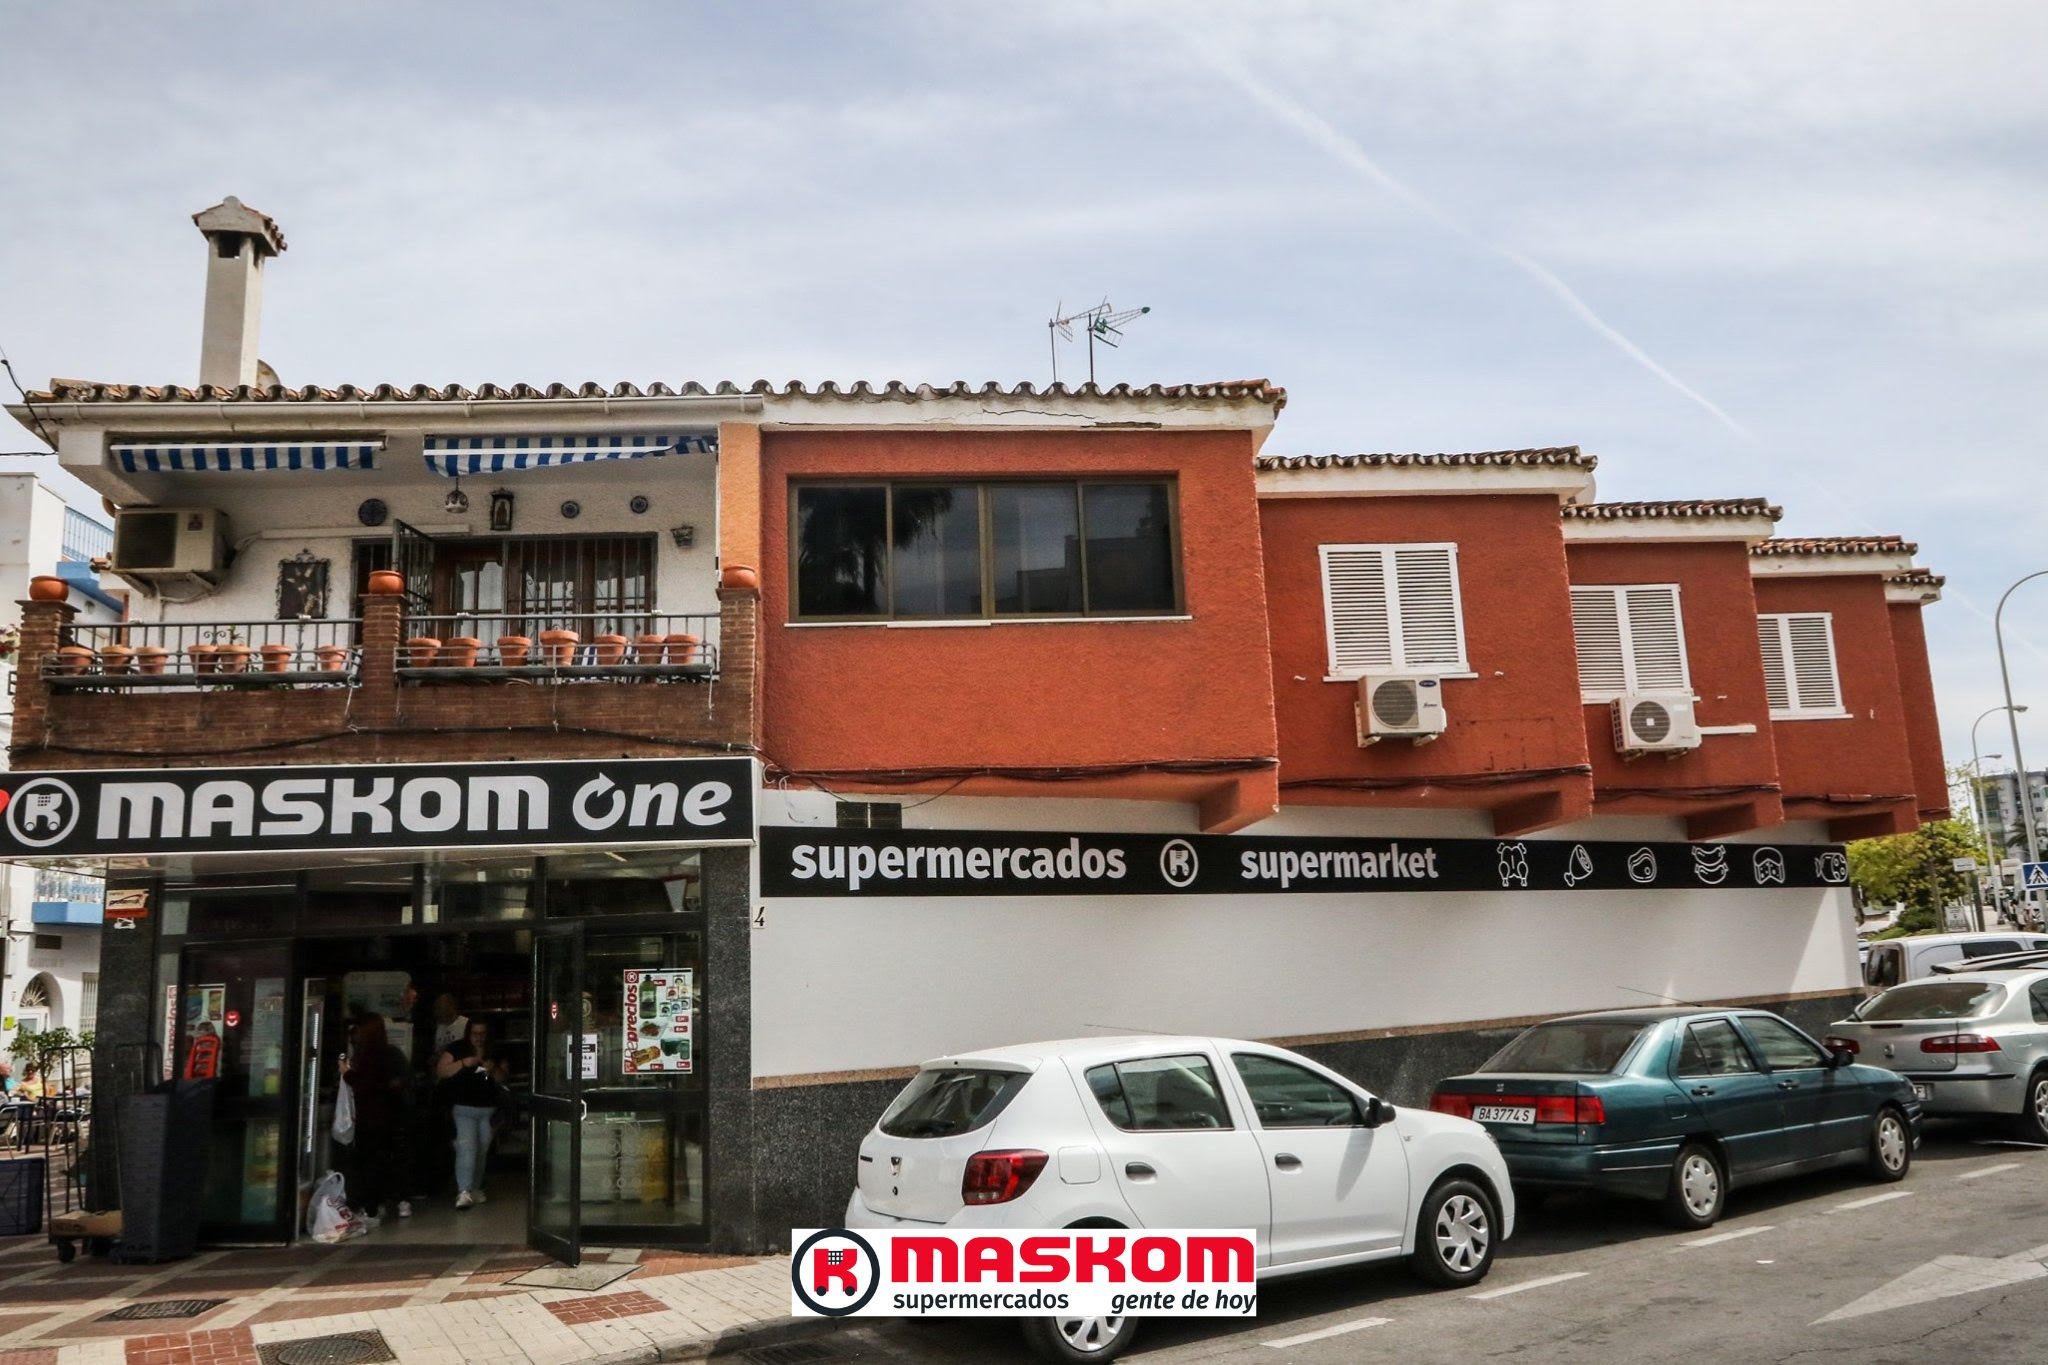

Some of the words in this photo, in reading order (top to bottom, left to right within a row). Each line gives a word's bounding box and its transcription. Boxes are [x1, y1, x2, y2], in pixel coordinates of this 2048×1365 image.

[97, 776, 549, 840] MASKOM
[791, 837, 1127, 891] supermercados
[1240, 843, 1439, 888] supermarket
[754, 906, 765, 927] 4
